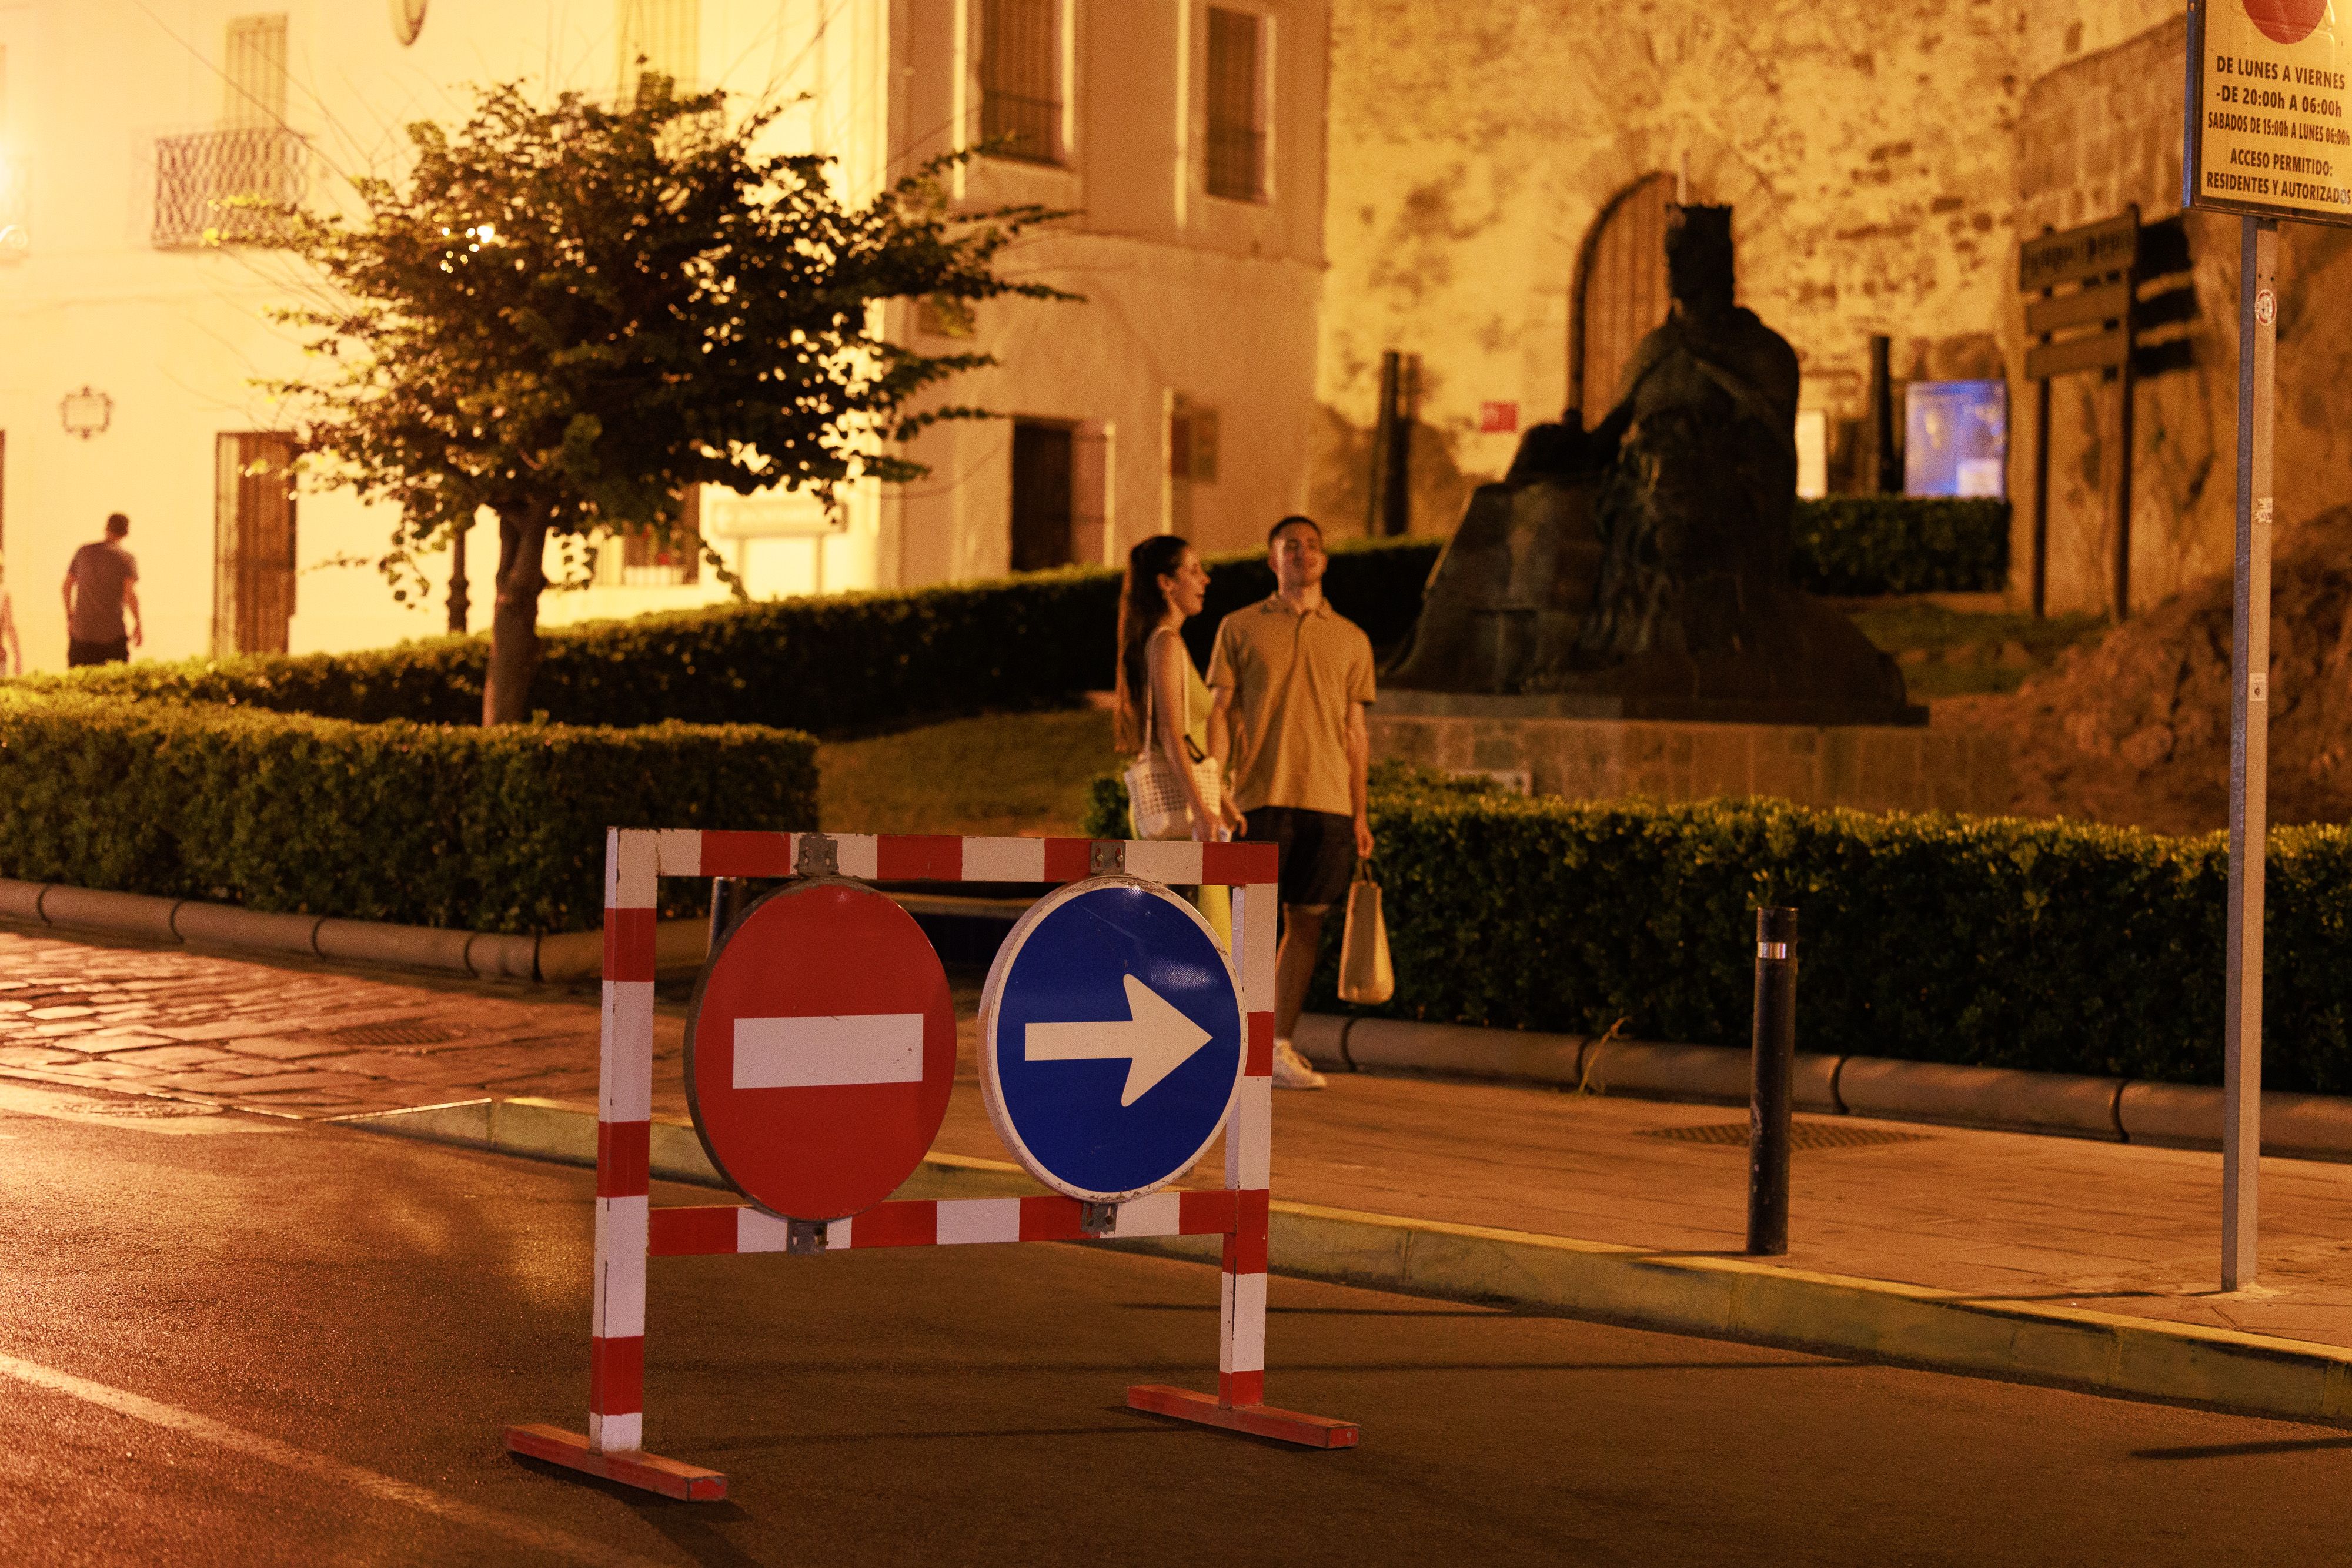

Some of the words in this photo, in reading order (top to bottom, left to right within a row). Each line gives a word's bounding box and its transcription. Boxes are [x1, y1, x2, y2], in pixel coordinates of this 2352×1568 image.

[2216, 56, 2233, 74] DE
[2237, 58, 2278, 80] LUNES
[2283, 65, 2291, 82] A
[2295, 66, 2345, 89] VIERNES
[2243, 88, 2285, 109] 20:00h
[2289, 93, 2298, 111] A
[2302, 96, 2342, 118] 06:00h
[2208, 111, 2248, 132] SABADOS
[2250, 116, 2260, 134] DE
[2263, 118, 2289, 137] 15:00h
[2291, 122, 2297, 139] A
[2299, 122, 2324, 142] LUNES
[2326, 126, 2350, 146] 06:00h
[2230, 148, 2270, 168] ACCESO
[2273, 153, 2333, 177] PERMITIDO:
[2207, 171, 2269, 195] RESIDENTES
[2272, 179, 2279, 196] Y
[2281, 181, 2351, 205] AUTORIZADOS
